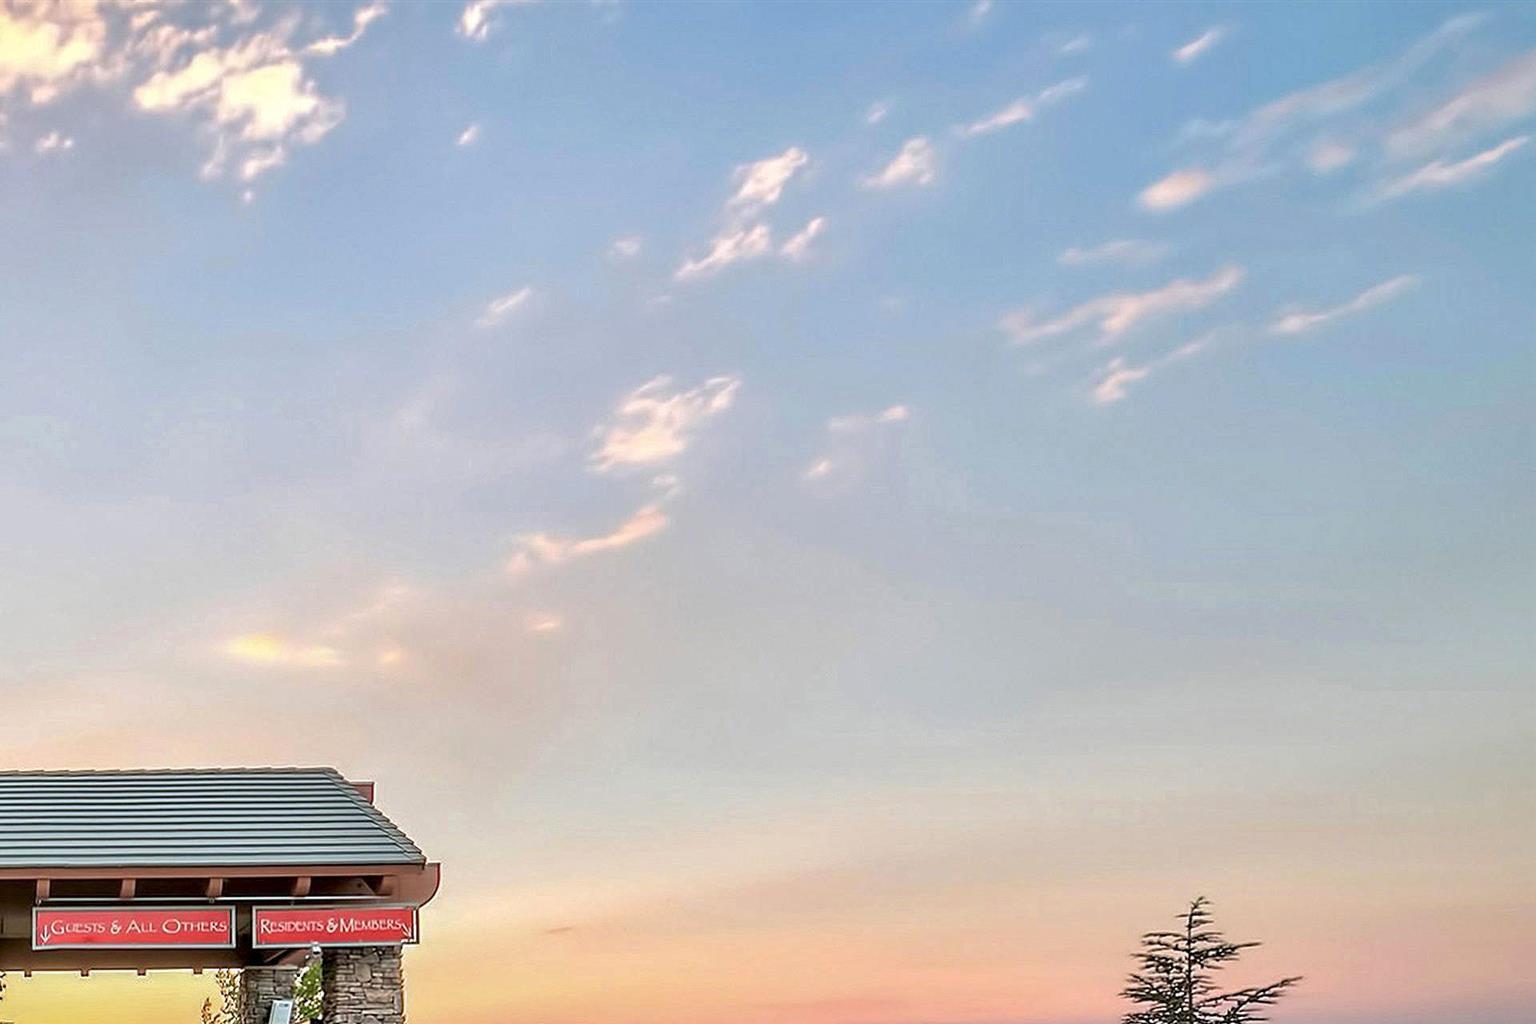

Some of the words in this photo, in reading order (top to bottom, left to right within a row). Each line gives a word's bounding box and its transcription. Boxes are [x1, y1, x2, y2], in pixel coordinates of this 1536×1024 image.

[50, 918, 106, 935] GUESTS
[110, 918, 121, 934] &
[125, 918, 157, 934] ALL
[162, 917, 228, 934] OTHERS
[259, 917, 324, 935] RESIDENTS
[326, 916, 339, 934] &
[339, 917, 402, 933] MEMBERS
